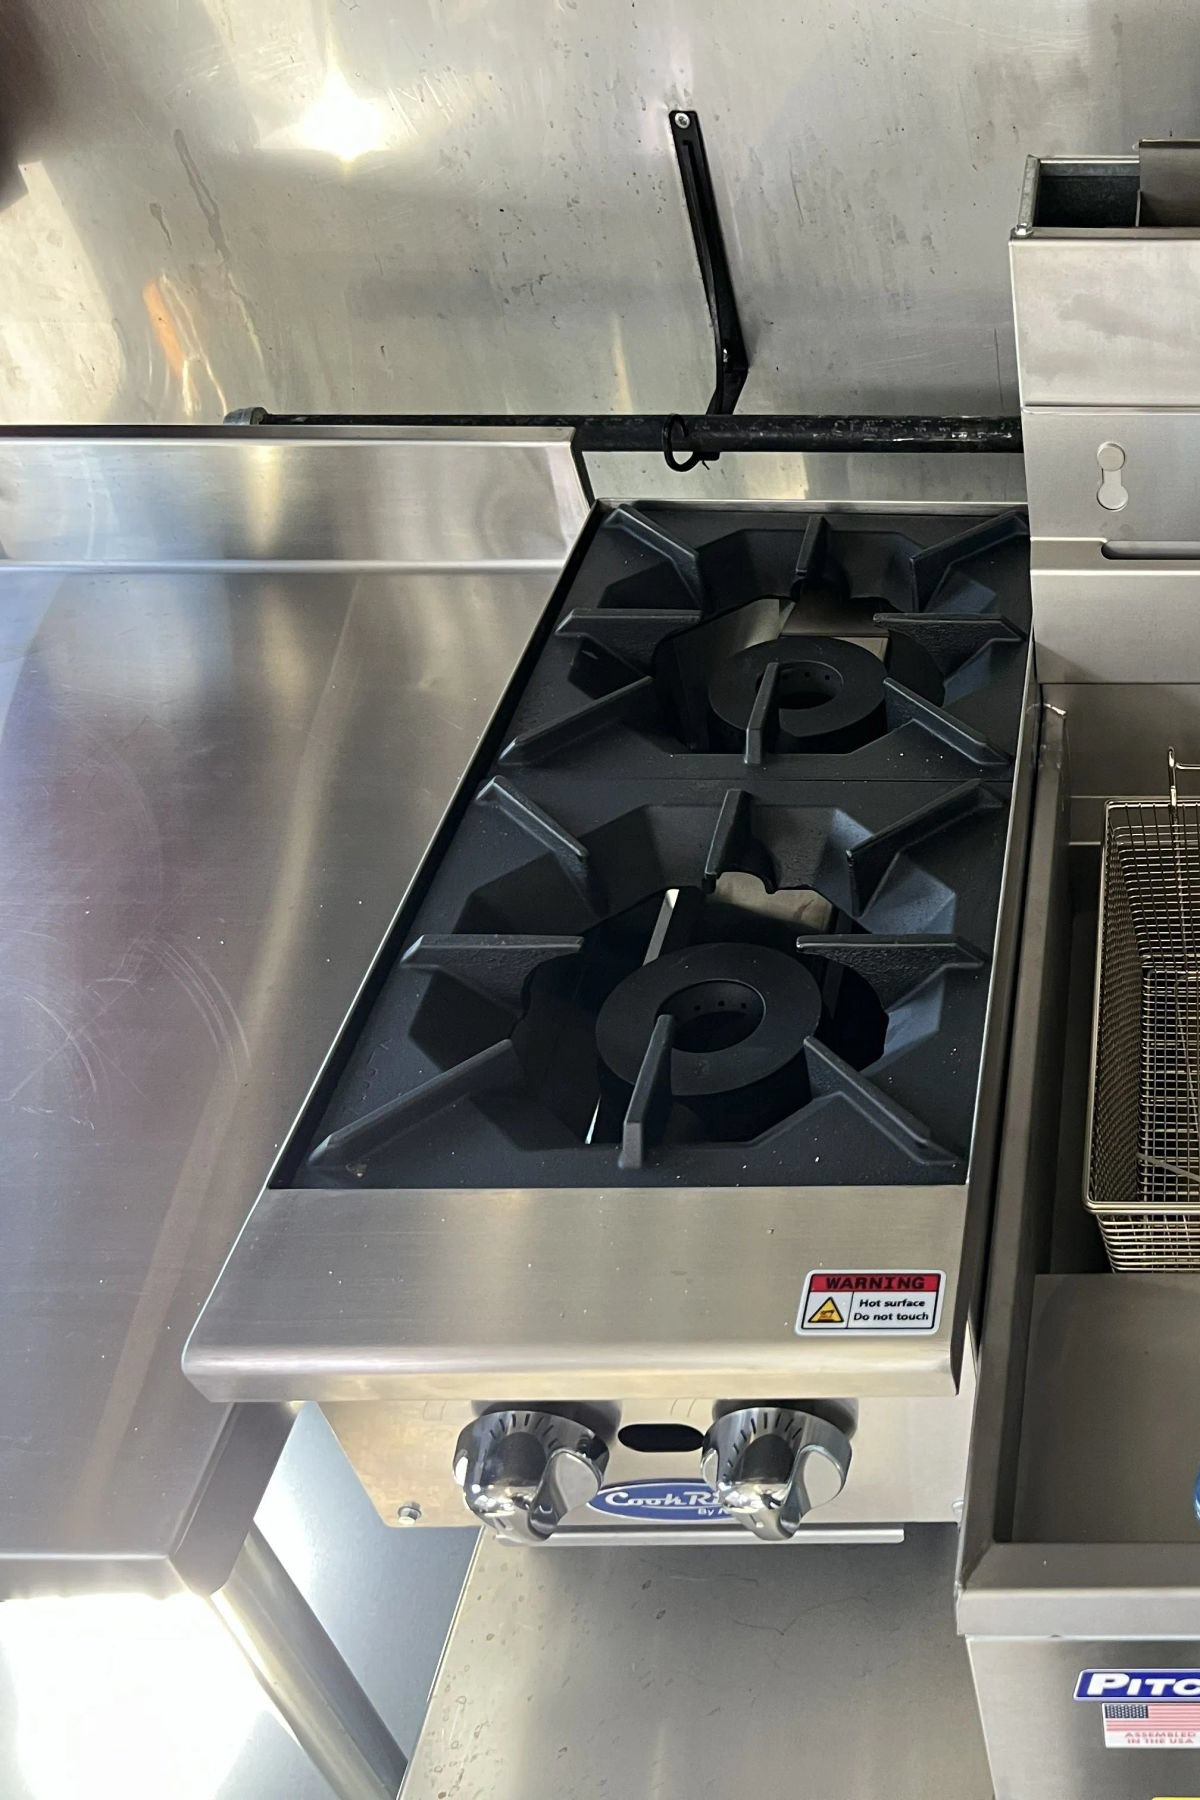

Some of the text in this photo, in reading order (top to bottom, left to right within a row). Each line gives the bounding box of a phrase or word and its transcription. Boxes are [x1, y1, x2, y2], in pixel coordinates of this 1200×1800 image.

[826, 1276, 926, 1290] WARNING
[859, 1298, 926, 1308] Hot surface
[853, 1312, 929, 1321] Do not touch
